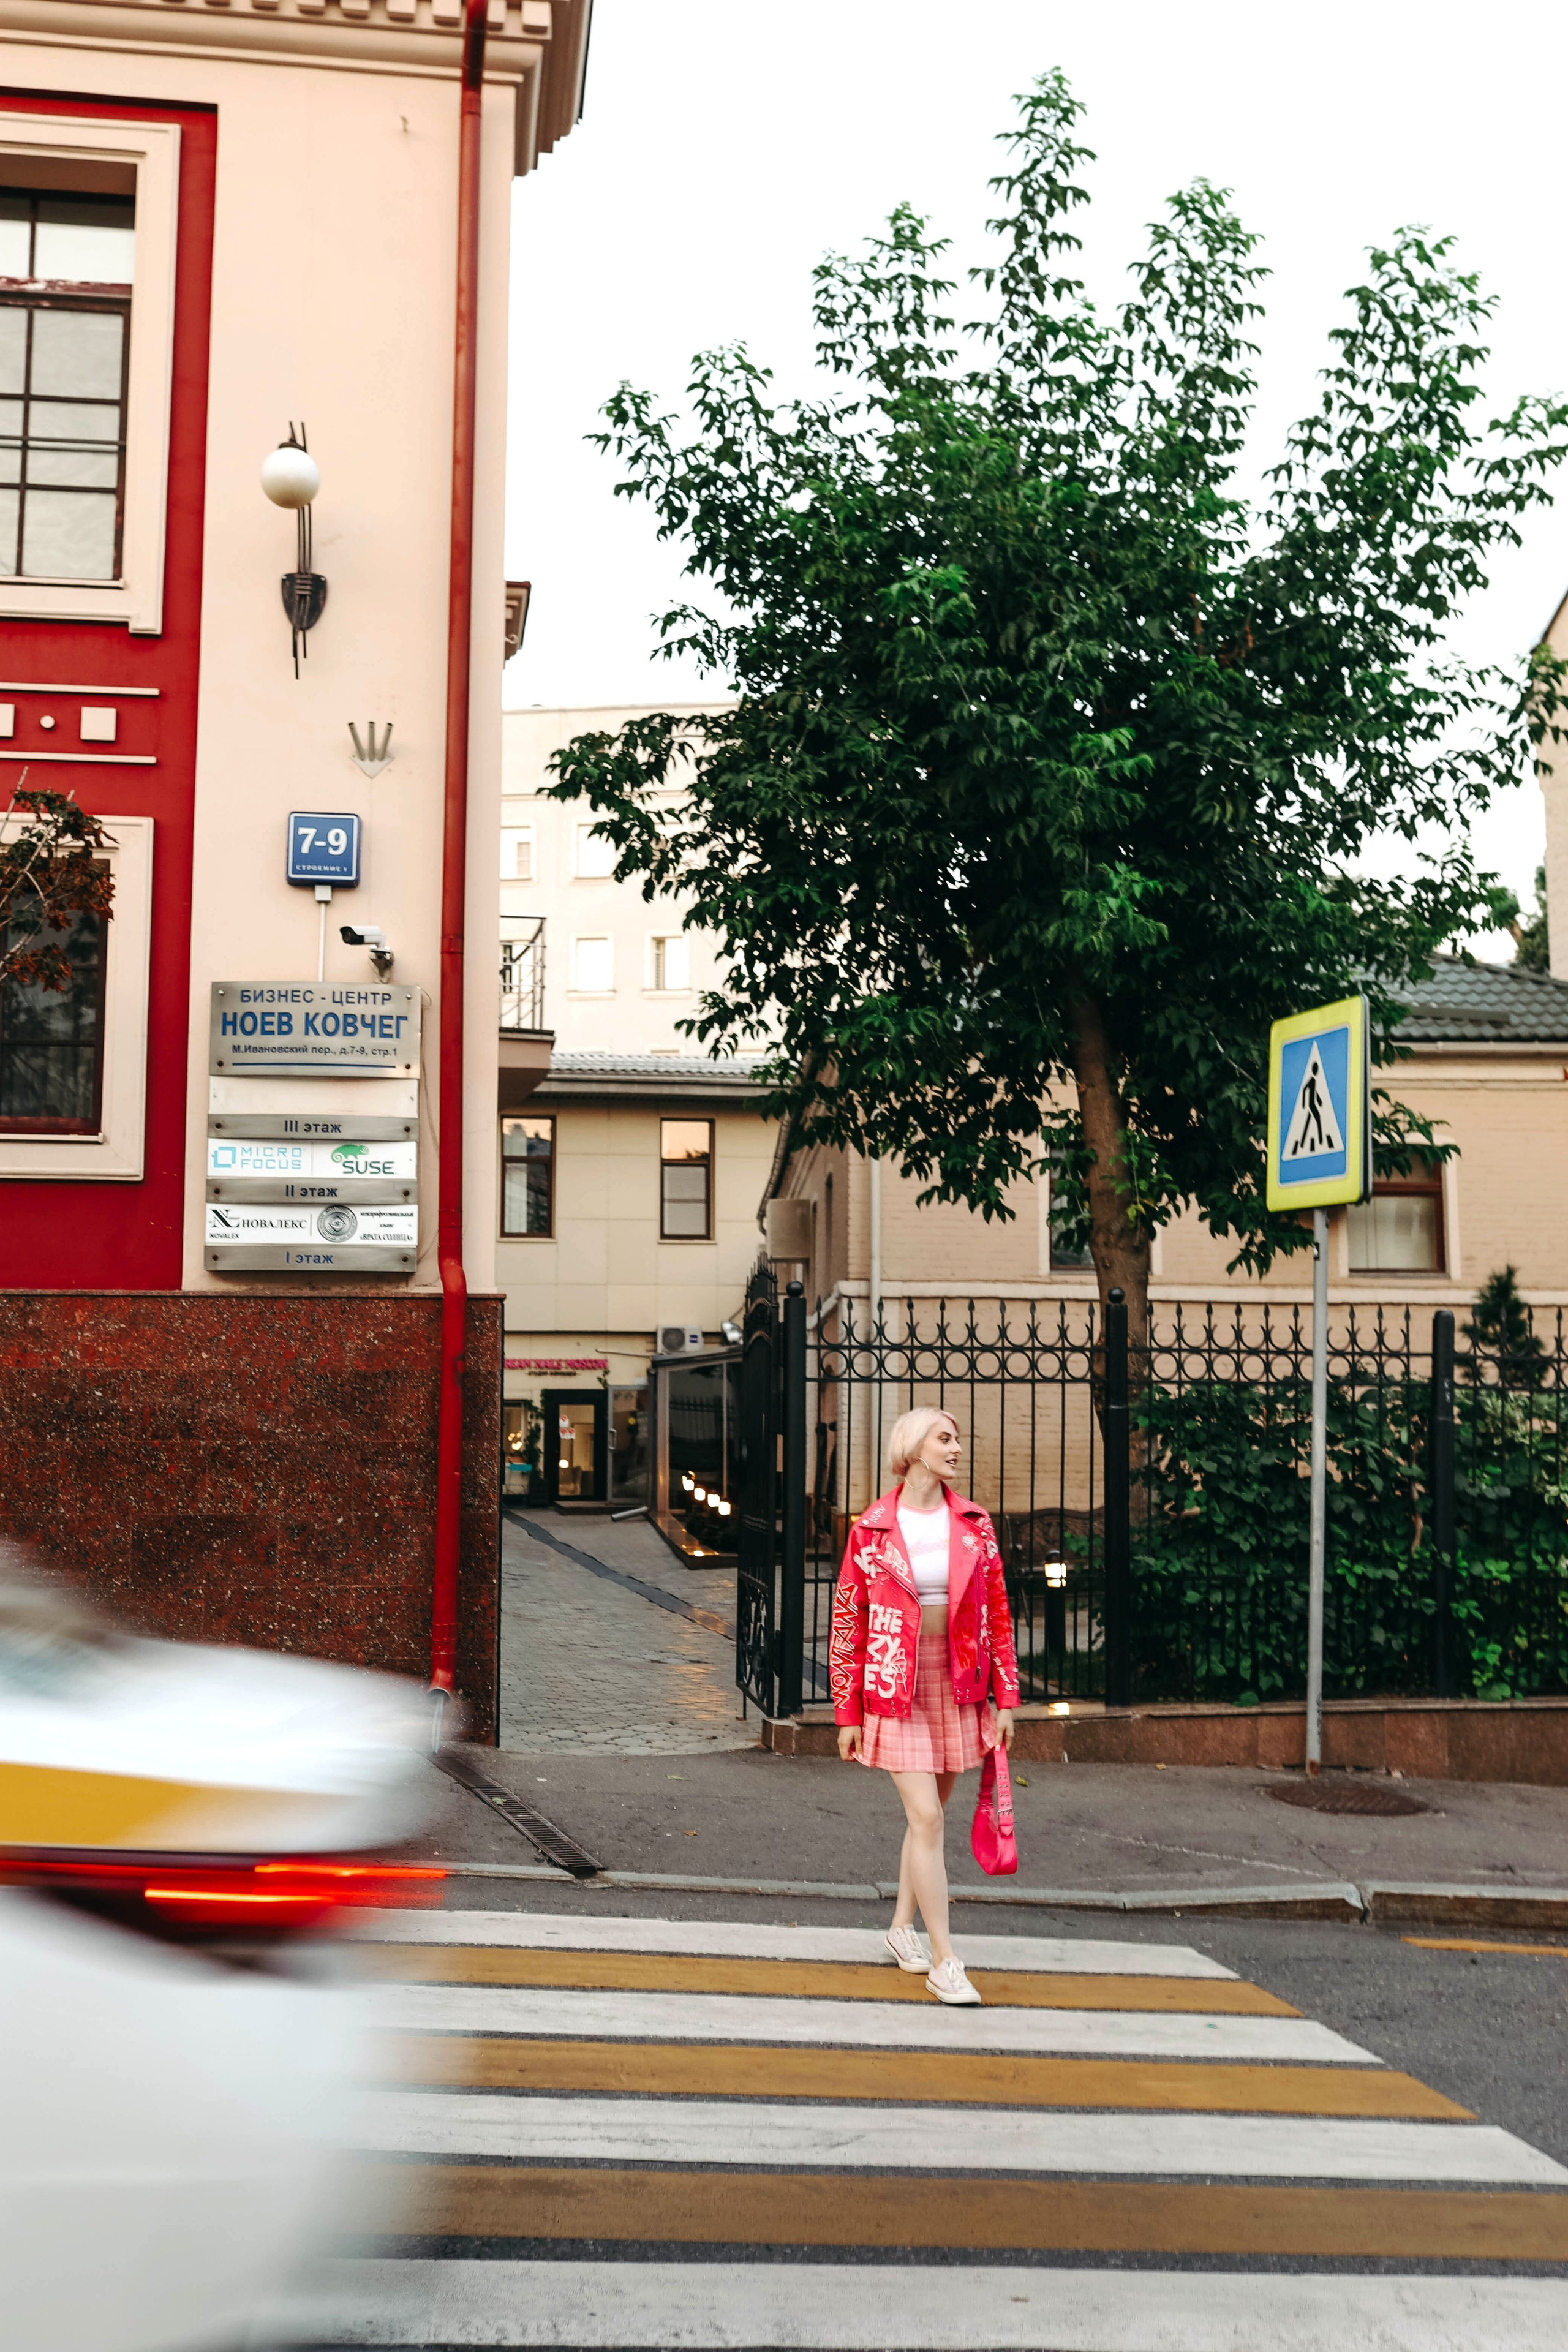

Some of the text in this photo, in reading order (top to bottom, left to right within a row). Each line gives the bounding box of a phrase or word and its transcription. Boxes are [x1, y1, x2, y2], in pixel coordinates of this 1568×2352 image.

[298, 827, 347, 855] 7-9
[240, 990, 314, 1003] БИЗНЕС
[332, 991, 391, 1006] ЦЕНТР
[222, 1012, 408, 1039] НОЕВ КОВЧЕГ
[285, 1120, 341, 1133] III этаж
[241, 1147, 301, 1157] MICRO
[241, 1159, 301, 1169] FOCUS
[342, 1161, 394, 1175] SUSE
[285, 1185, 337, 1196] II этаж
[242, 1219, 307, 1229] НОВАЛЕКС
[286, 1251, 334, 1264] I этаж
[868, 1603, 903, 1634] THE
